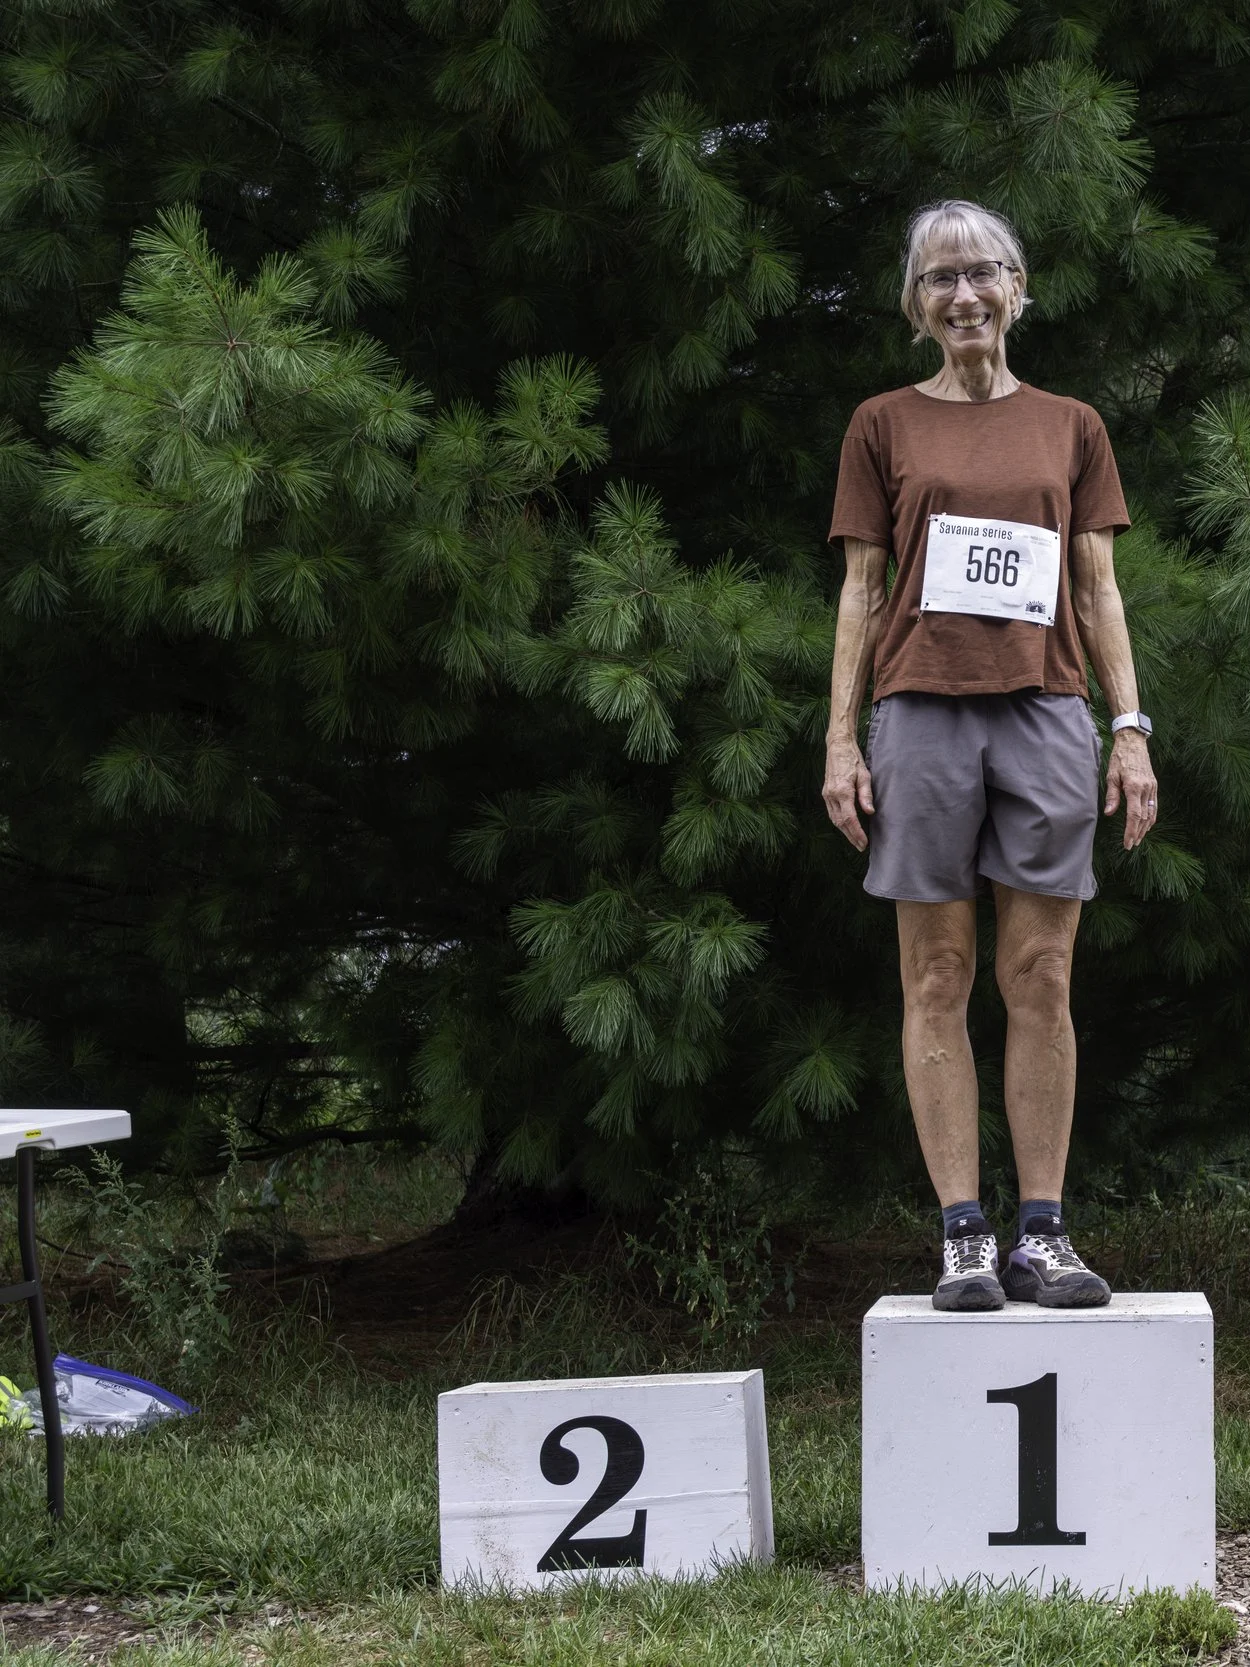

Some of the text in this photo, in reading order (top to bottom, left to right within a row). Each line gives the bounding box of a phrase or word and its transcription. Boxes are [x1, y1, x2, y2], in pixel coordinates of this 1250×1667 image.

[939, 521, 980, 537] Savanna
[982, 527, 1013, 541] series
[966, 545, 1020, 587] 566
[537, 1415, 648, 1575] 2
[987, 1373, 1087, 1547] 1
